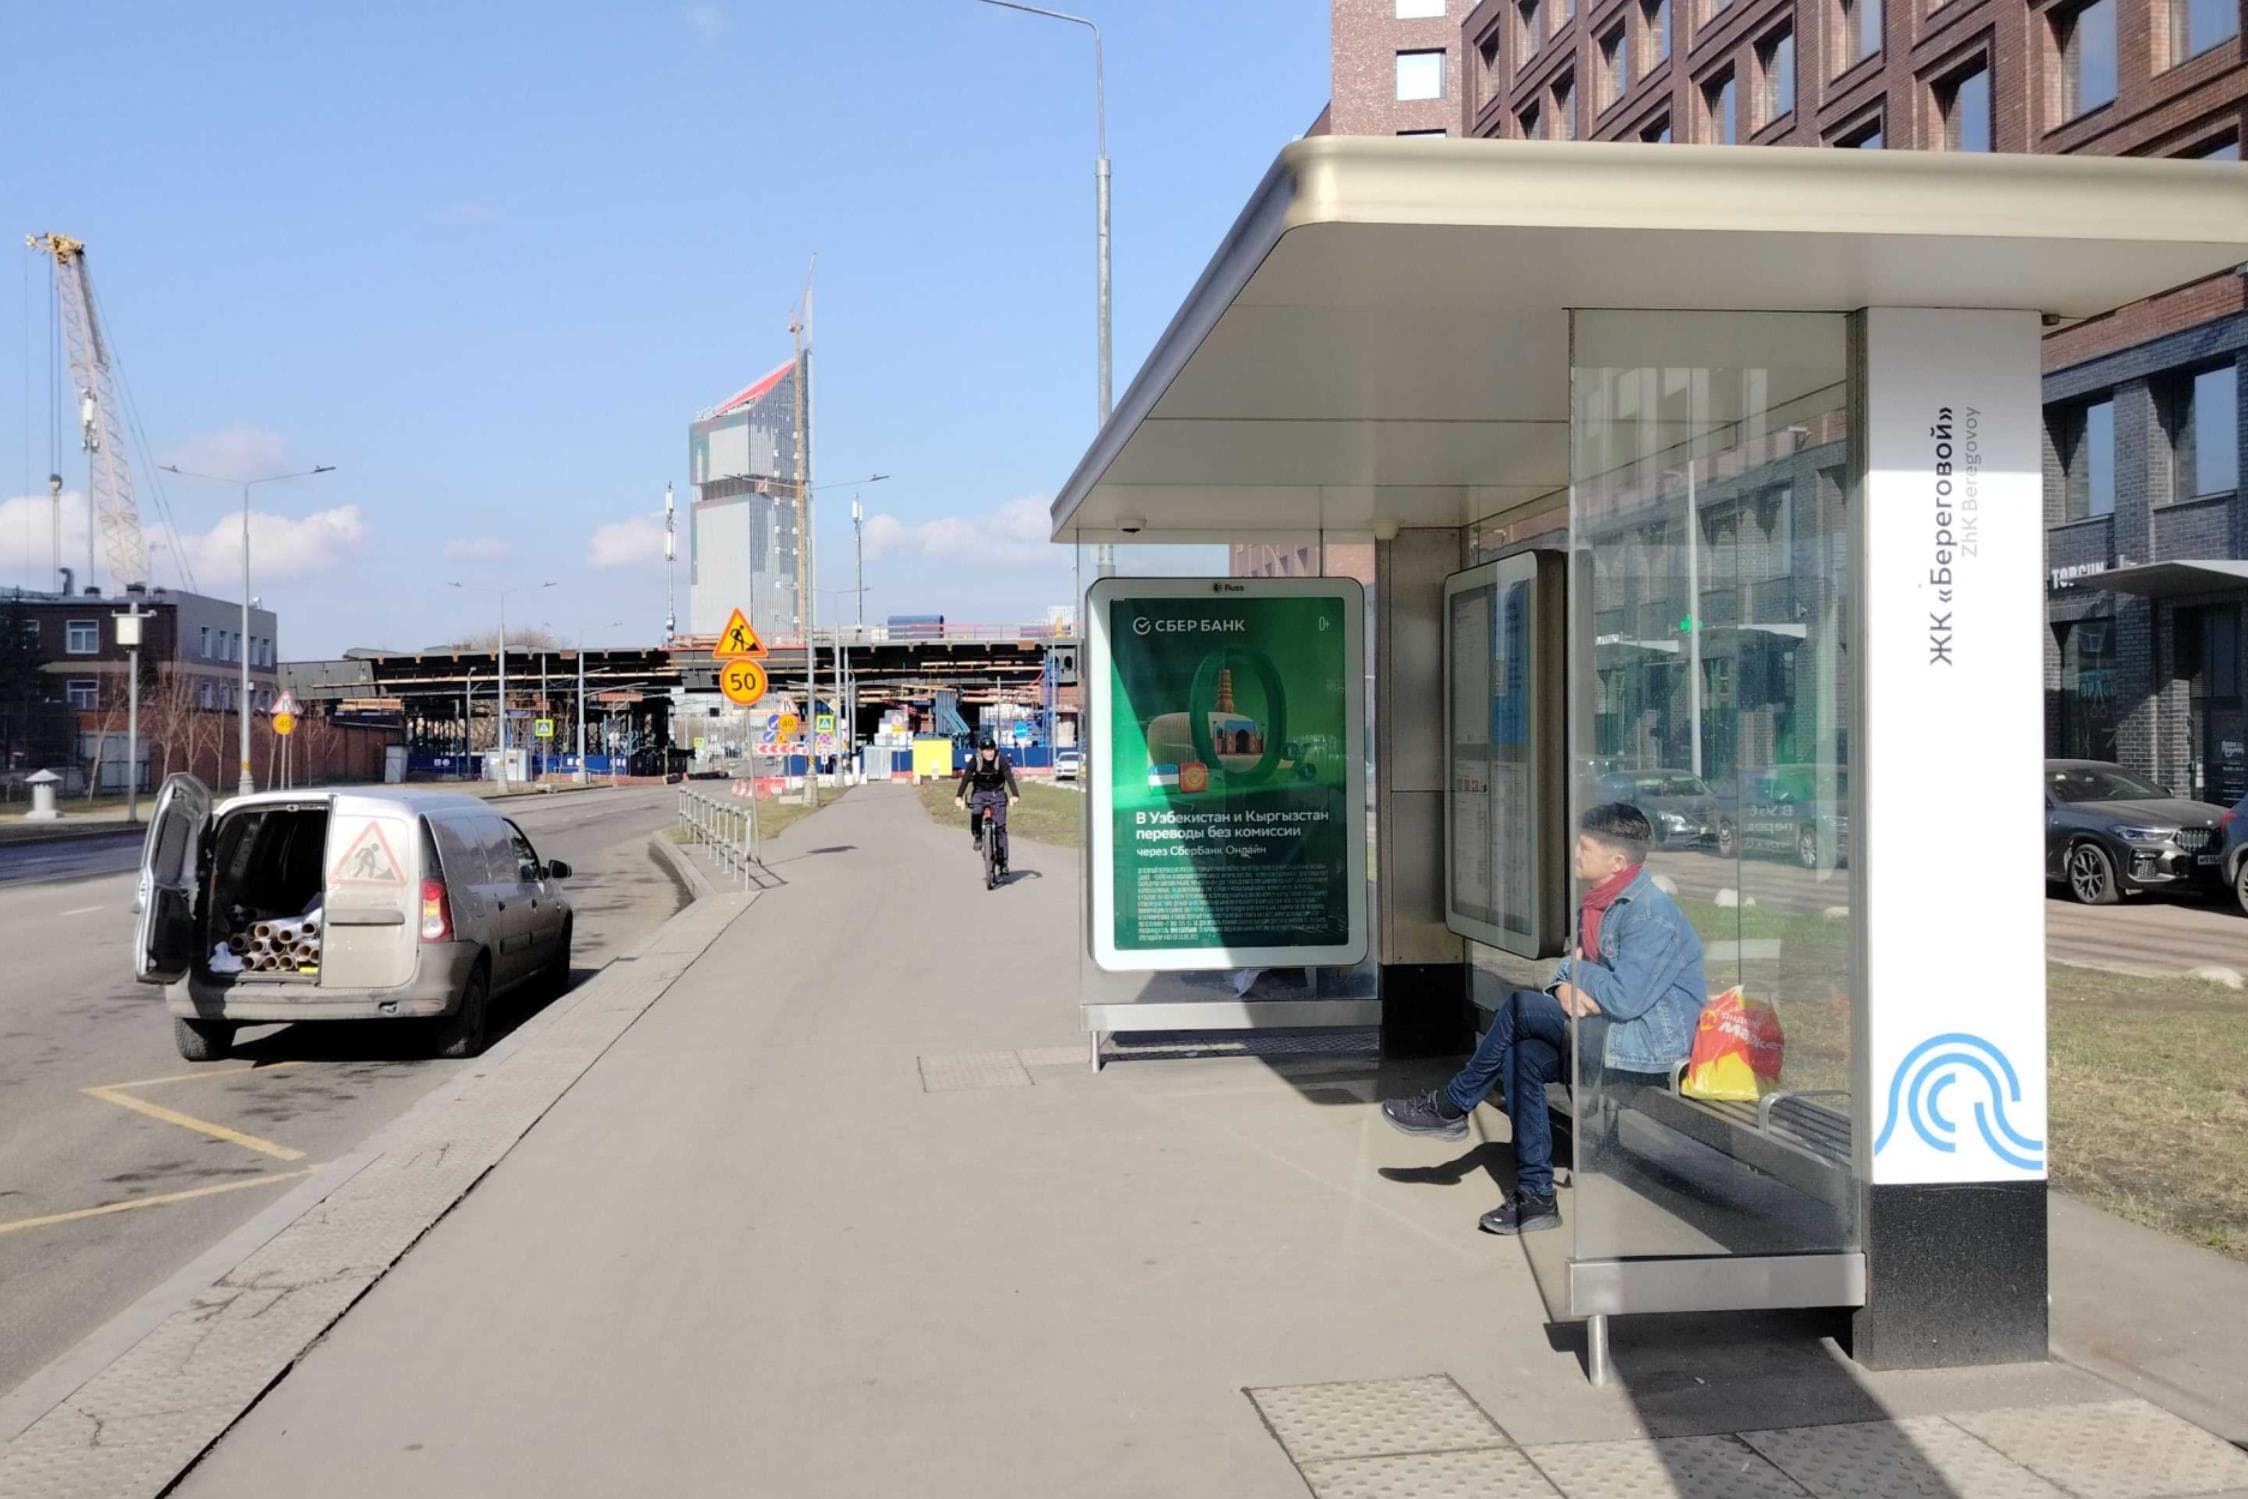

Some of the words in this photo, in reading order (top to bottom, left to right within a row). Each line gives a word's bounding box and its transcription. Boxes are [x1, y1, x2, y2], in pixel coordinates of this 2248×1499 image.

[1961, 405, 1982, 512] Beregovoy
[1929, 406, 1958, 603] «Береговой»
[1961, 516, 1977, 558] ZhK
[1155, 619, 1198, 632] СБЕР
[1201, 619, 1246, 632] БАНК
[1318, 615, 1331, 632] 0+
[1929, 611, 1952, 667] ЖК
[730, 672, 756, 692] 50
[1136, 811, 1146, 824] В
[1149, 811, 1231, 824] Узбекистан
[1234, 812, 1243, 822] и
[1246, 810, 1329, 825] Кыргызстан
[1136, 828, 1205, 841] переводы
[1207, 825, 1231, 838] без
[1235, 826, 1301, 838] комиссии
[1136, 846, 1168, 857] через
